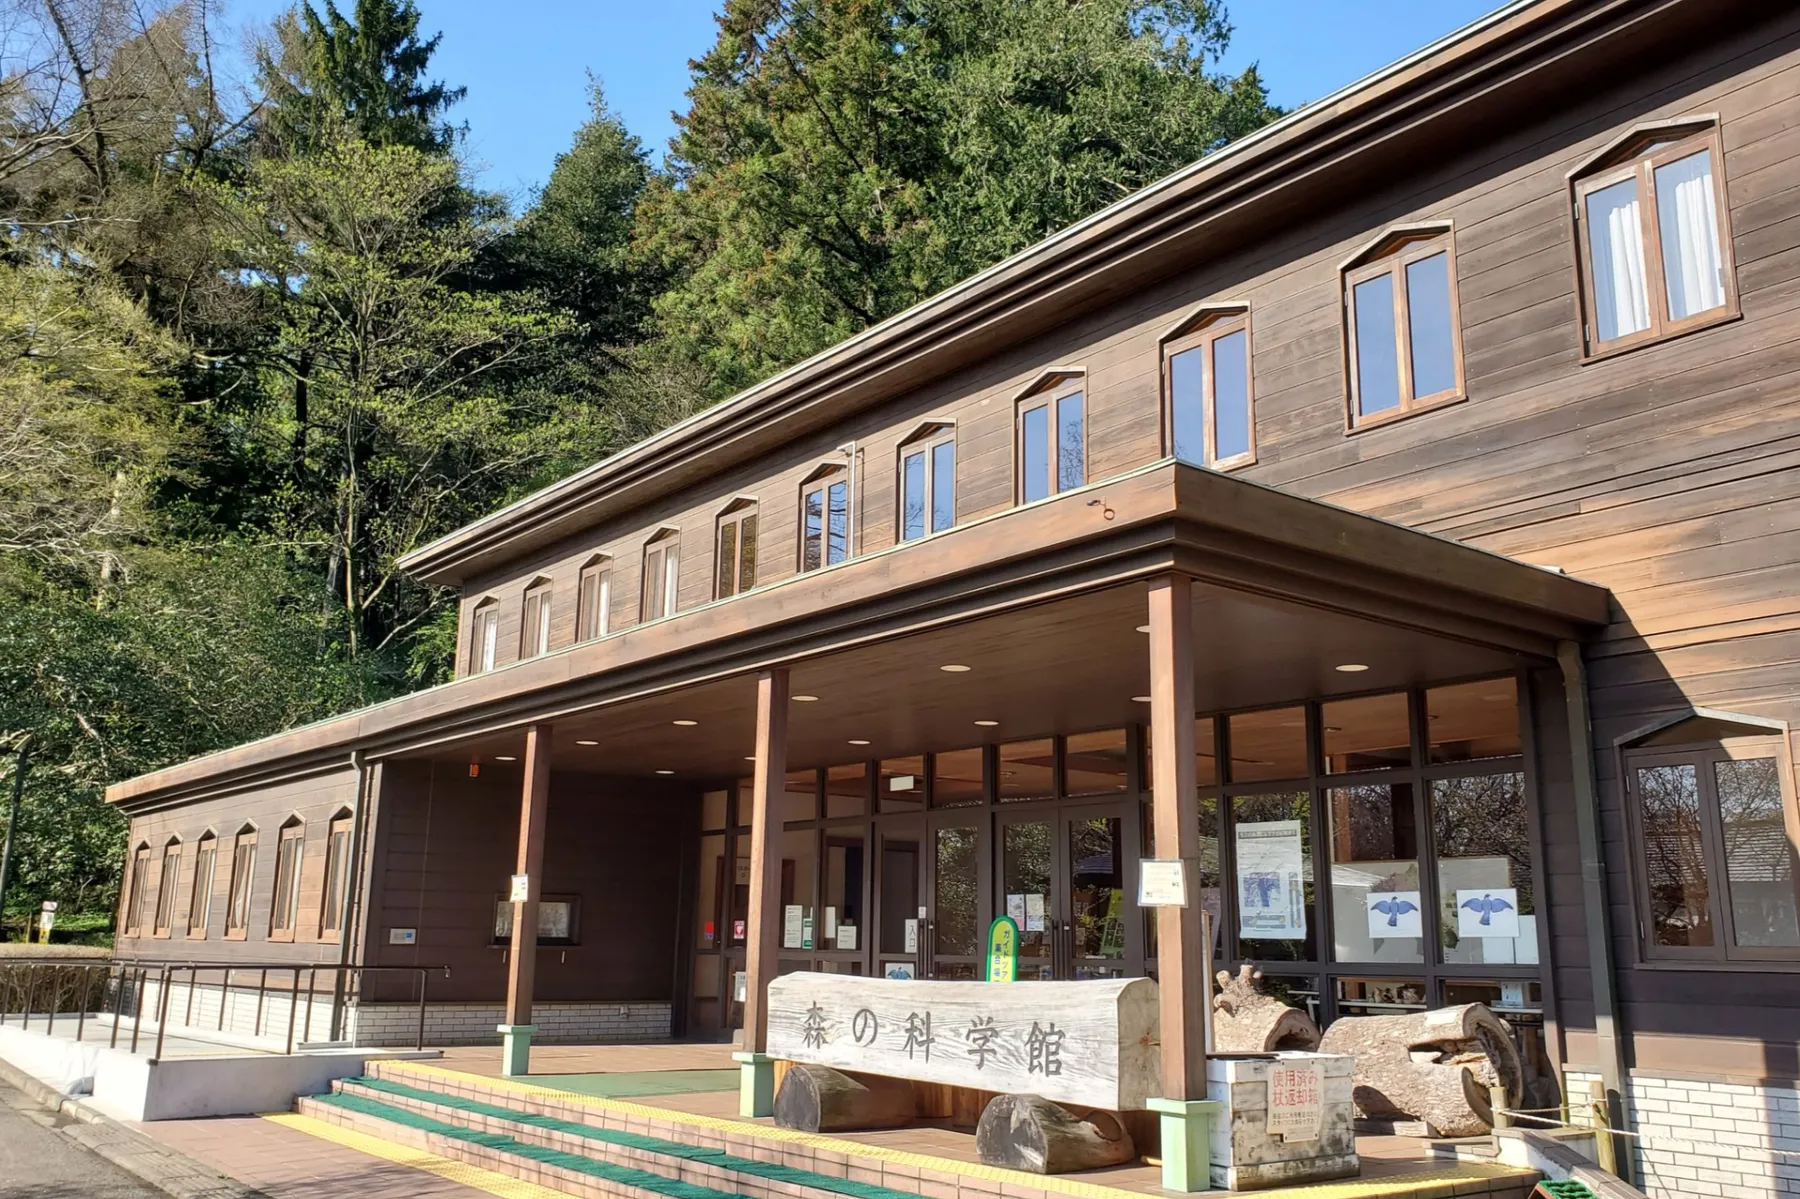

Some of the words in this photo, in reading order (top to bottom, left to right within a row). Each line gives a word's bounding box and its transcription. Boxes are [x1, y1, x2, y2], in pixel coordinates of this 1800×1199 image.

[909, 924, 916, 948] 入口
[993, 943, 1002, 982] 集合場
[801, 1000, 1067, 1077] 森の科学館
[1272, 1069, 1319, 1088] 使用済み
